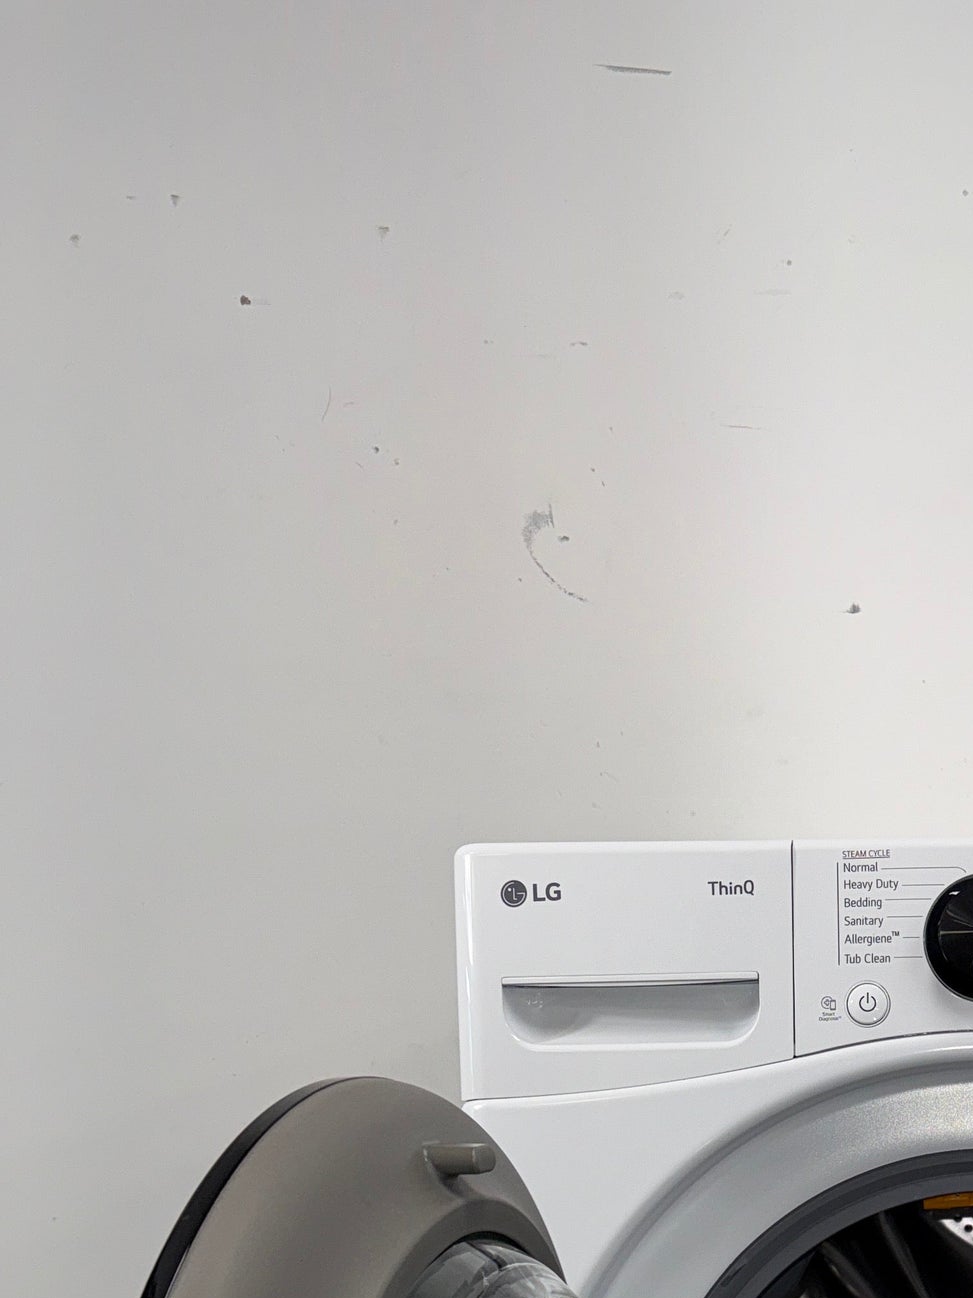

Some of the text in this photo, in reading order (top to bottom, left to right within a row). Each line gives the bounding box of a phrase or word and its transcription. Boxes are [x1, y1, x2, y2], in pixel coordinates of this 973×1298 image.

[842, 849, 890, 858] STEAM CYCLE
[843, 862, 878, 872] Normal
[708, 880, 755, 896] ThinQ
[843, 879, 899, 891] Heavy Duty
[532, 882, 562, 902] LG
[844, 897, 882, 909] Bedding
[844, 916, 884, 928] Sanitary
[844, 953, 891, 964] Tub Clean
